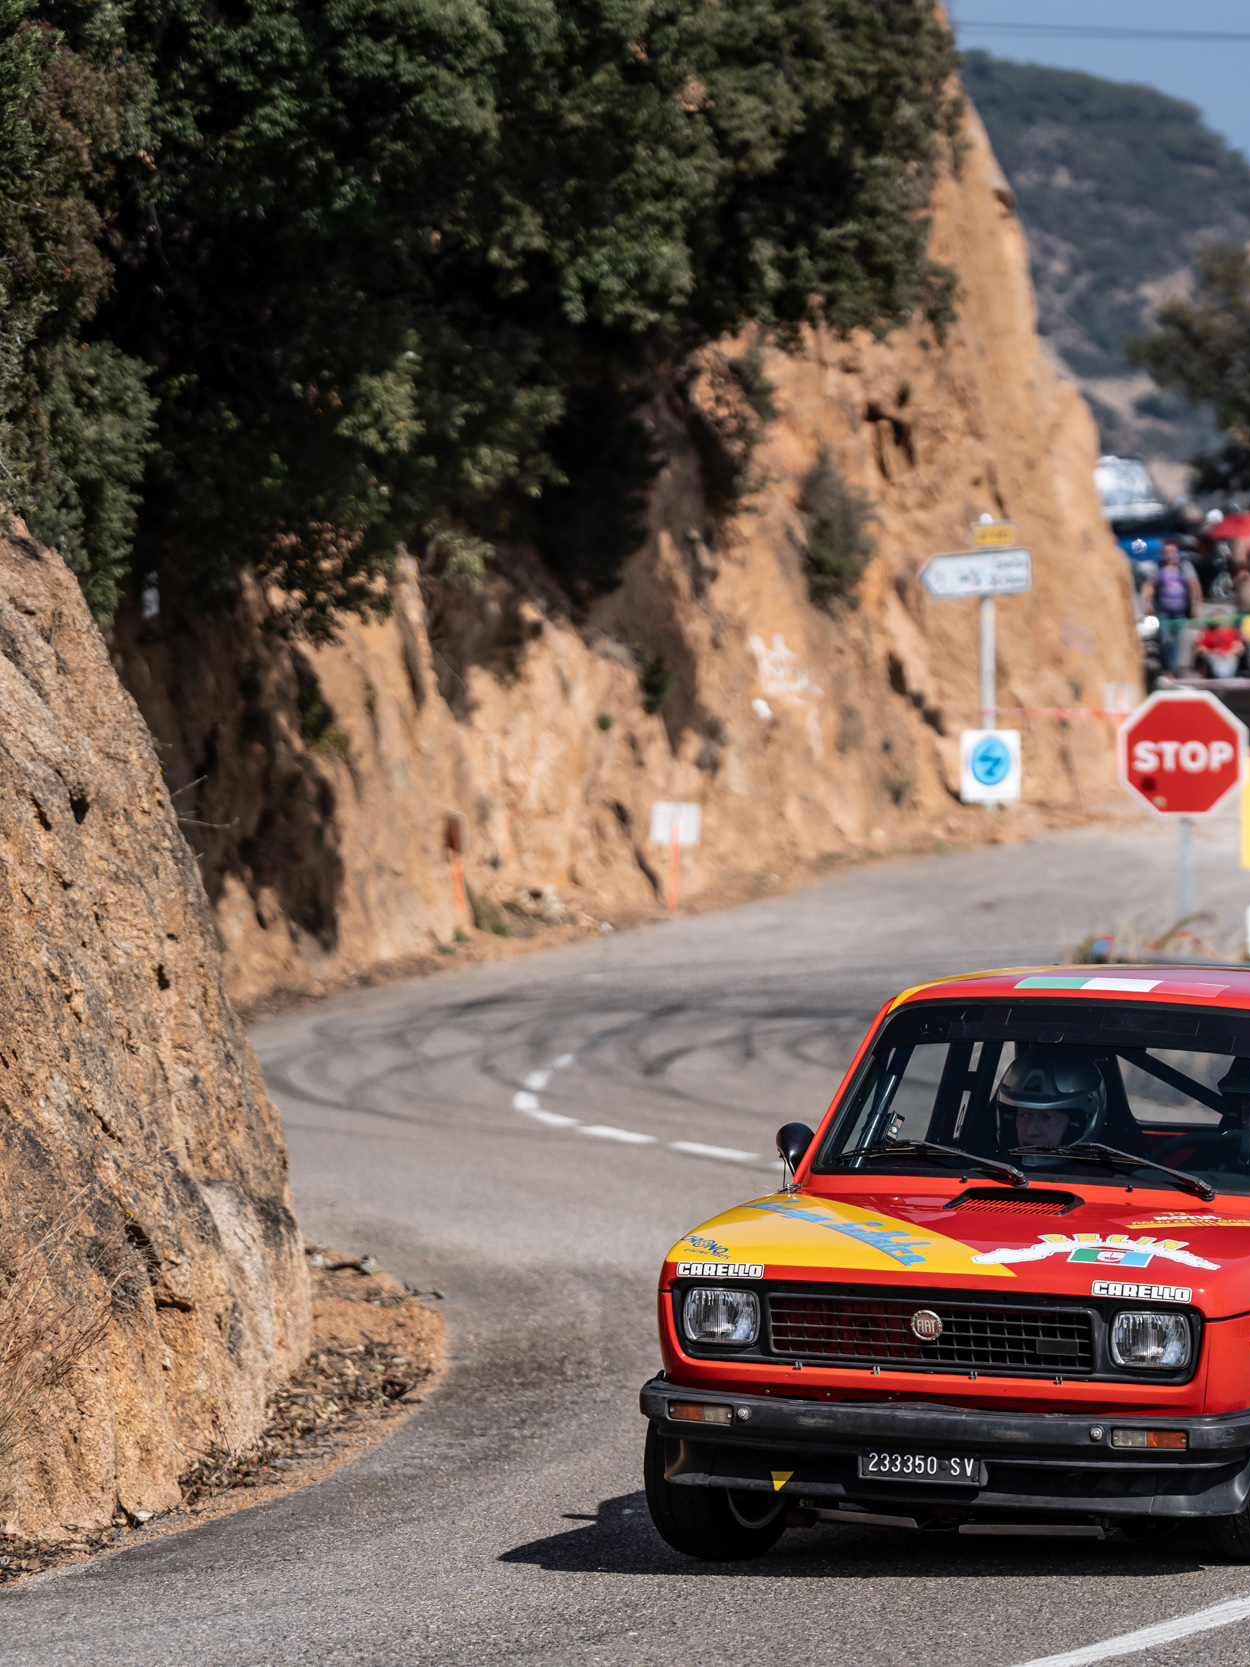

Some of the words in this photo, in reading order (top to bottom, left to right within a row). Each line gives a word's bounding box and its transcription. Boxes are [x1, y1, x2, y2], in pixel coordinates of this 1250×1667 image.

[1132, 740, 1234, 773] STOP
[1040, 1233, 1189, 1251] BELIN
[679, 1263, 763, 1278] CARELLO
[1093, 1282, 1191, 1301] CARELLO
[916, 1319, 936, 1333] FIAT
[868, 1453, 937, 1475] 233350
[950, 1457, 974, 1478] SV
